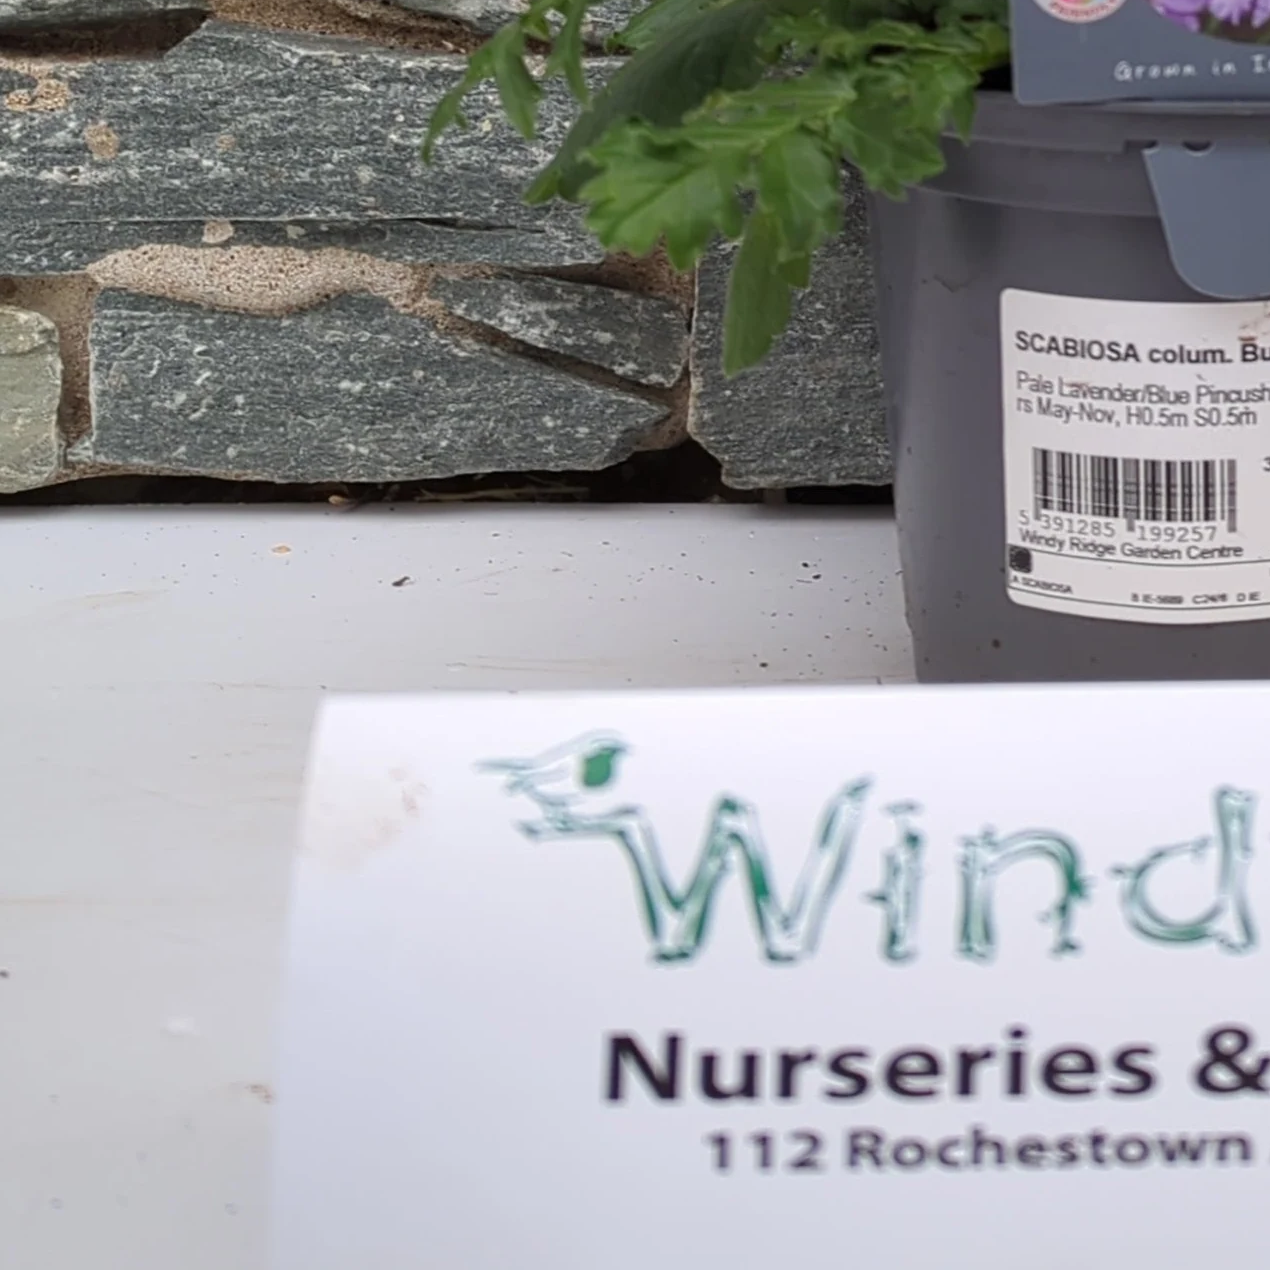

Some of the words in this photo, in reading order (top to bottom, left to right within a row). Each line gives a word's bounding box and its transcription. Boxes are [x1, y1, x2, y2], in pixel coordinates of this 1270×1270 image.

[1114, 60, 1197, 81] Grown
[1212, 58, 1236, 76] in
[1015, 331, 1141, 362] SCABIOSA
[1148, 345, 1233, 364] colum.
[1016, 370, 1054, 394] Pale
[1058, 377, 1190, 405] Lavender/Blue
[1016, 397, 1033, 413] rs
[1037, 397, 1120, 427] May-Nov,
[1127, 406, 1188, 427] H0.5m
[1194, 407, 1257, 427] S0.5m
[1018, 510, 1030, 525] 5
[1041, 514, 1116, 537] 391285
[1137, 525, 1217, 543] 199257
[1020, 528, 1064, 552] Windy
[1069, 537, 1117, 557] Ridge
[1120, 543, 1181, 560] Garden
[1185, 545, 1244, 559] Centre
[605, 1029, 1155, 1101] Nurseries
[709, 1130, 823, 1172] 112
[846, 1123, 1253, 1170] Rochestown
